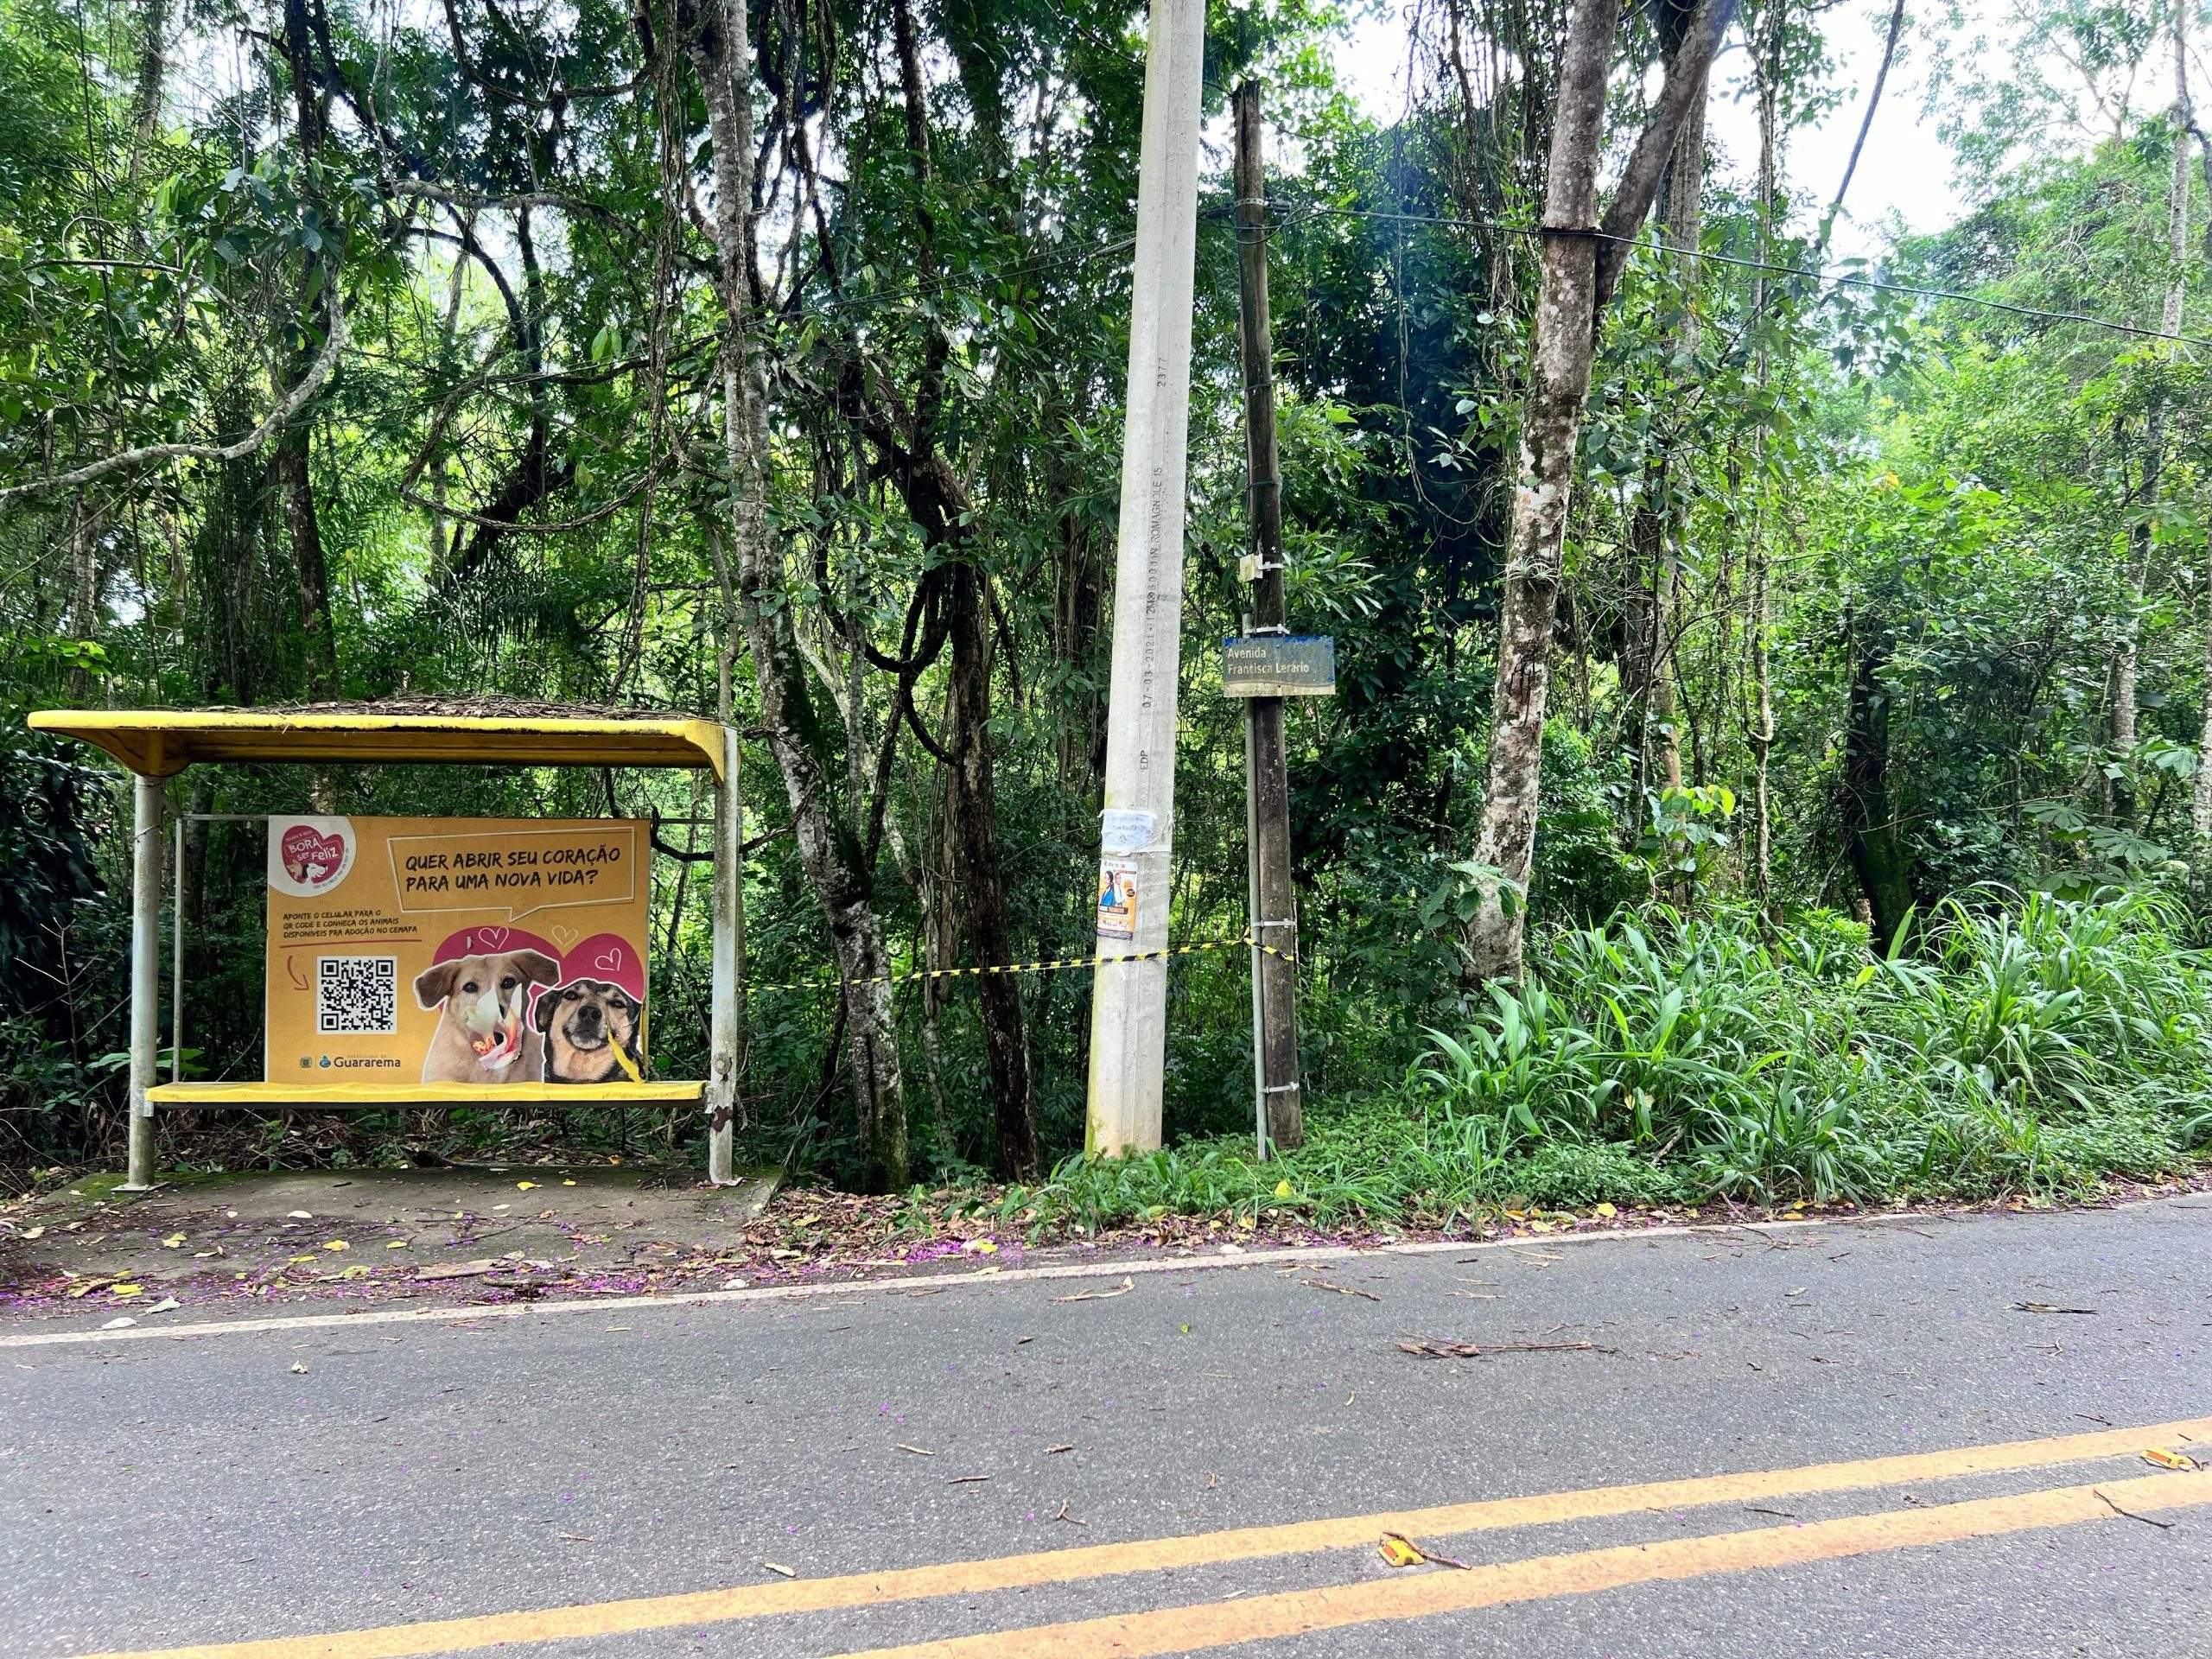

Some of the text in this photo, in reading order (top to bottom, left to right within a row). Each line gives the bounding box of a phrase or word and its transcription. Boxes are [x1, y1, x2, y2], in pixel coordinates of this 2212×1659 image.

[1227, 646, 1267, 659] Avenida
[1227, 663, 1273, 675] Francisca
[289, 836, 323, 854] BORA
[297, 852, 309, 861] ser
[405, 844, 621, 872] QUER ABRIR SEU CORAÇÃO
[405, 869, 599, 893] PARA UMA NOVA VIDA?
[283, 912, 312, 921] APONTE
[283, 922, 294, 931] QR
[345, 926, 375, 936] ADOÇÃO
[389, 925, 417, 934] CEMAPA
[334, 1056, 401, 1068] Guararema
